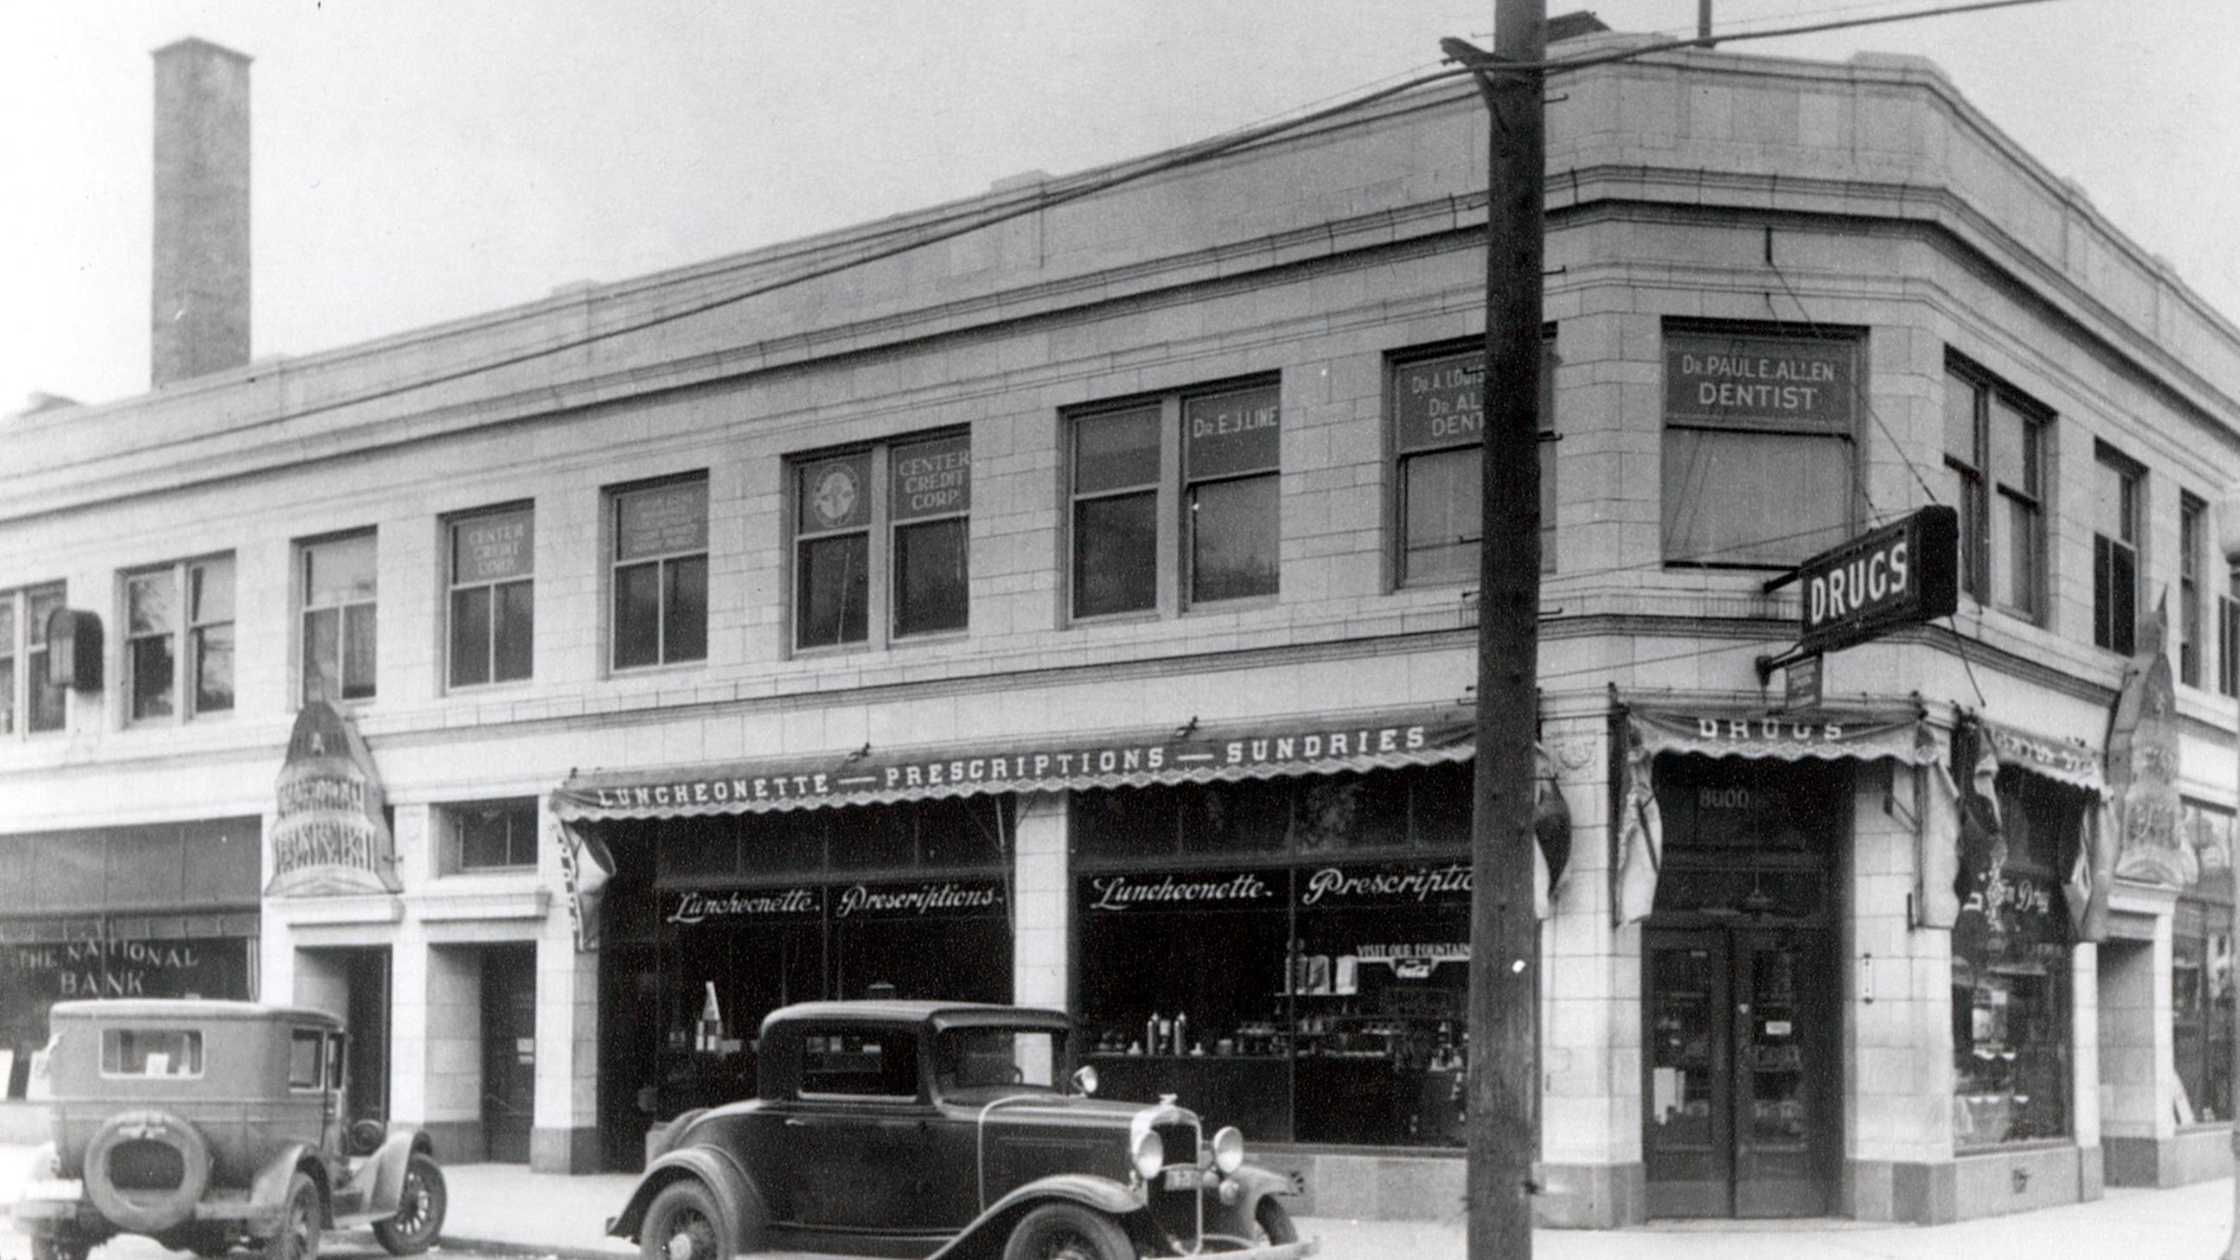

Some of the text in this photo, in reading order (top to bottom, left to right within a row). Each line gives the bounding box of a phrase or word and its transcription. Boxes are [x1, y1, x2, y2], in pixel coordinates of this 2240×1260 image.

[1707, 356, 1755, 378] PAUL
[1775, 360, 1834, 382] ALLEN
[1699, 382, 1818, 410] DENTIST
[1245, 406, 1278, 430] LINE
[900, 449, 970, 477] CENTER
[905, 469, 965, 494] CREDIT
[468, 522, 524, 546] CENTER
[1811, 542, 1908, 625] DRUGS
[1699, 719, 1842, 740] DRUGS
[599, 726, 1425, 807] LUNCHEONETTE PRESCRIPTIONS SUNDRIES
[17, 937, 199, 969] THE NATIONAL
[1357, 943, 1387, 958] VISIT
[60, 970, 145, 996] BANK
